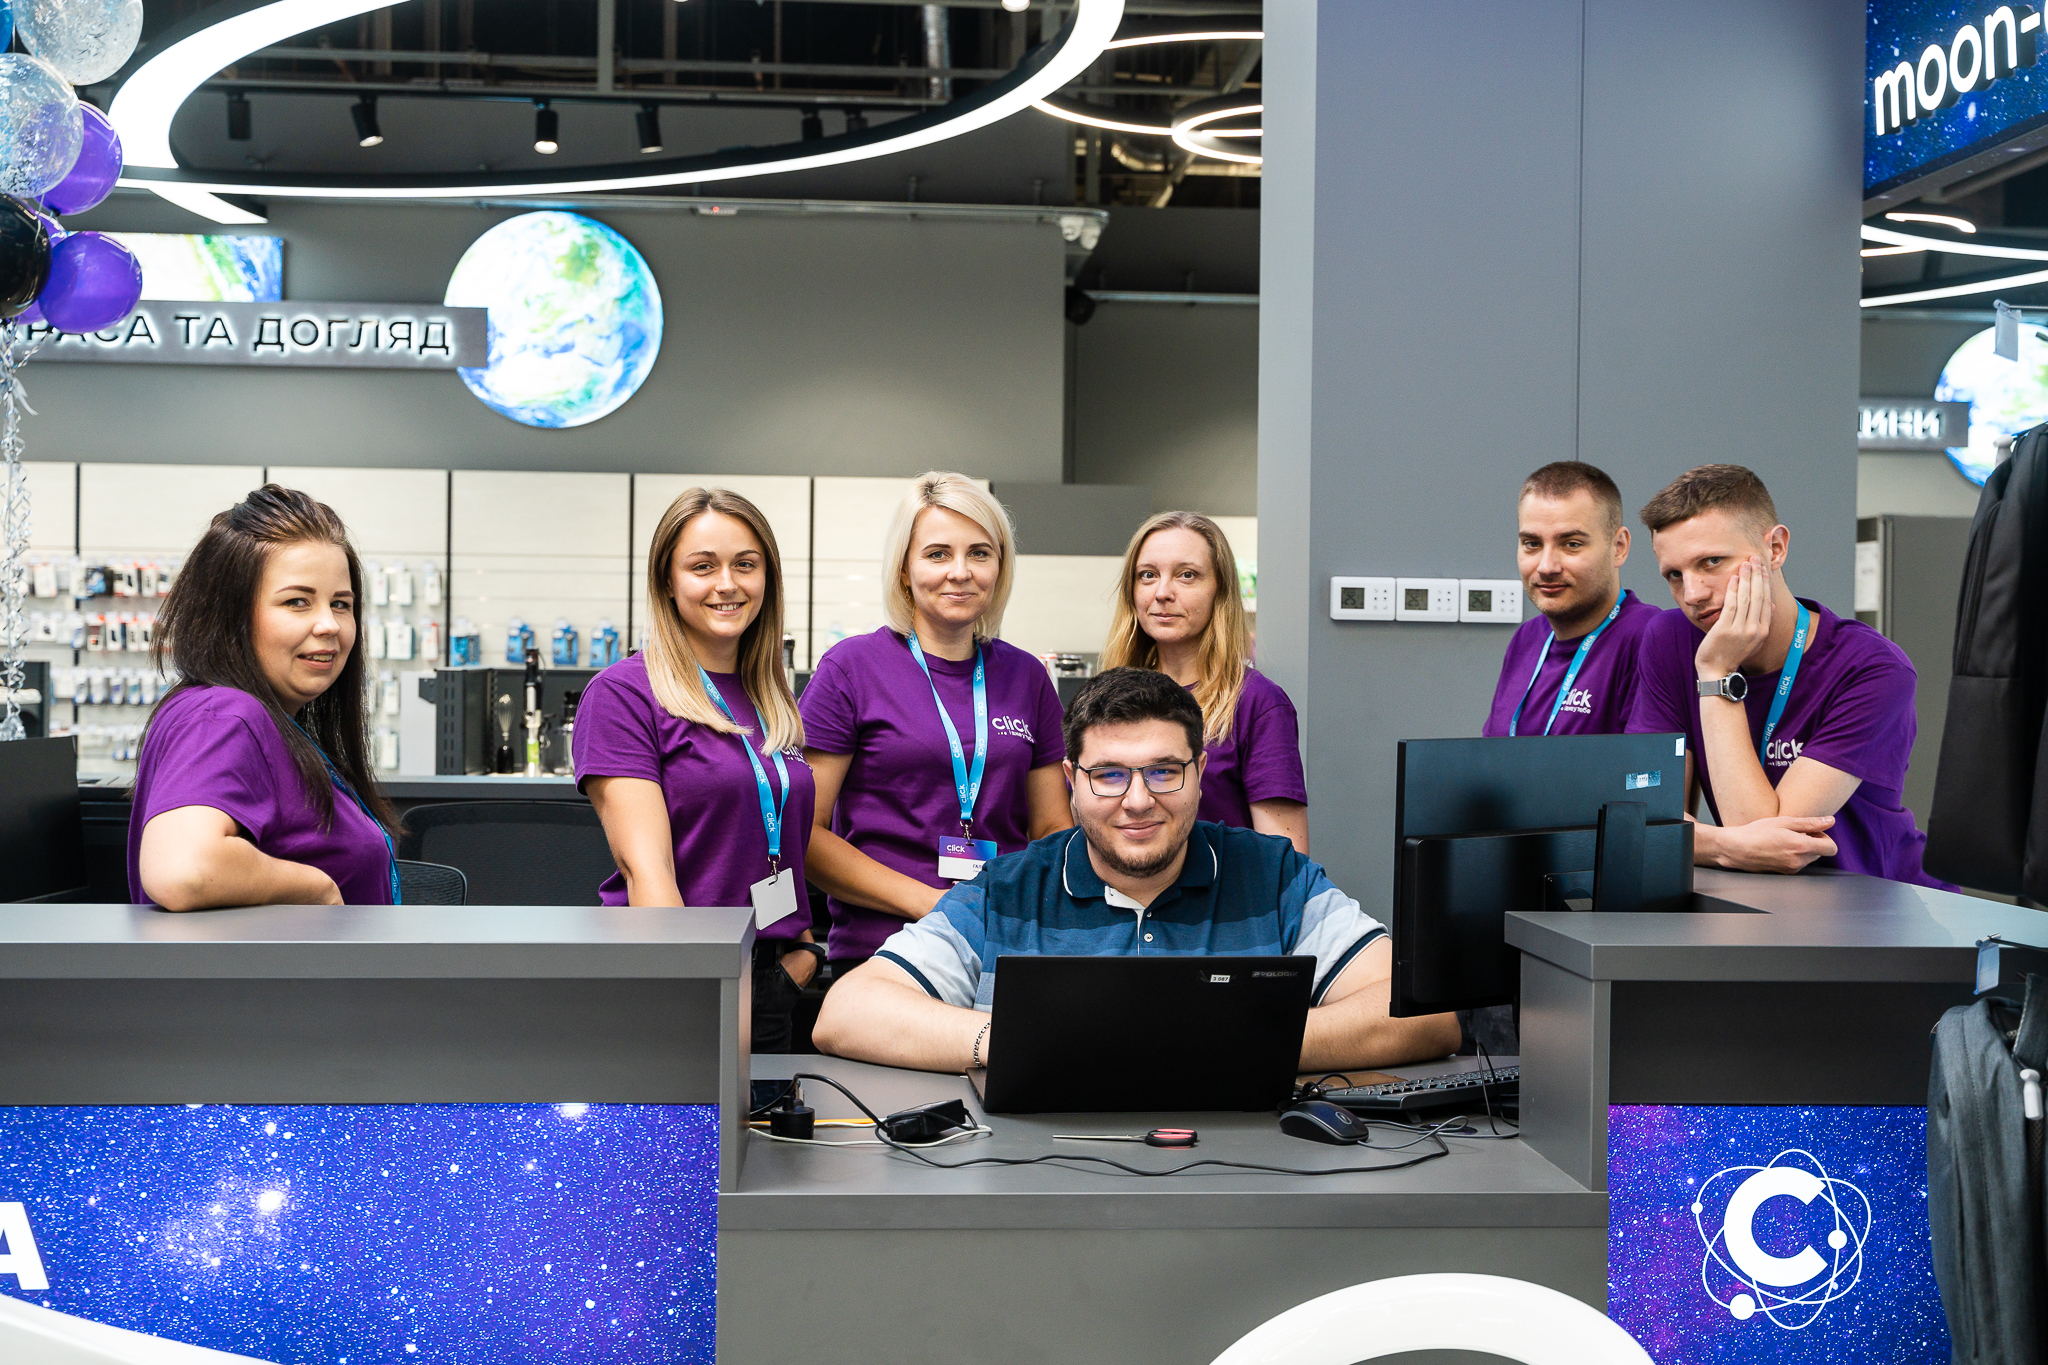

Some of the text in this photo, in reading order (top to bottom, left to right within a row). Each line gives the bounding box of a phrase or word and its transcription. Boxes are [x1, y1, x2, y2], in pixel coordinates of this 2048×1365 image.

[1874, 2, 2048, 137] moon-
[174, 315, 233, 345] ТА
[253, 317, 450, 355] ДОГЛЯД
[1858, 409, 1942, 437] ИНИ
[1793, 628, 1805, 649] click
[1779, 675, 1791, 696] click
[951, 739, 960, 758] click
[1766, 738, 1804, 759] click
[766, 812, 777, 833] click
[946, 843, 966, 853] click
